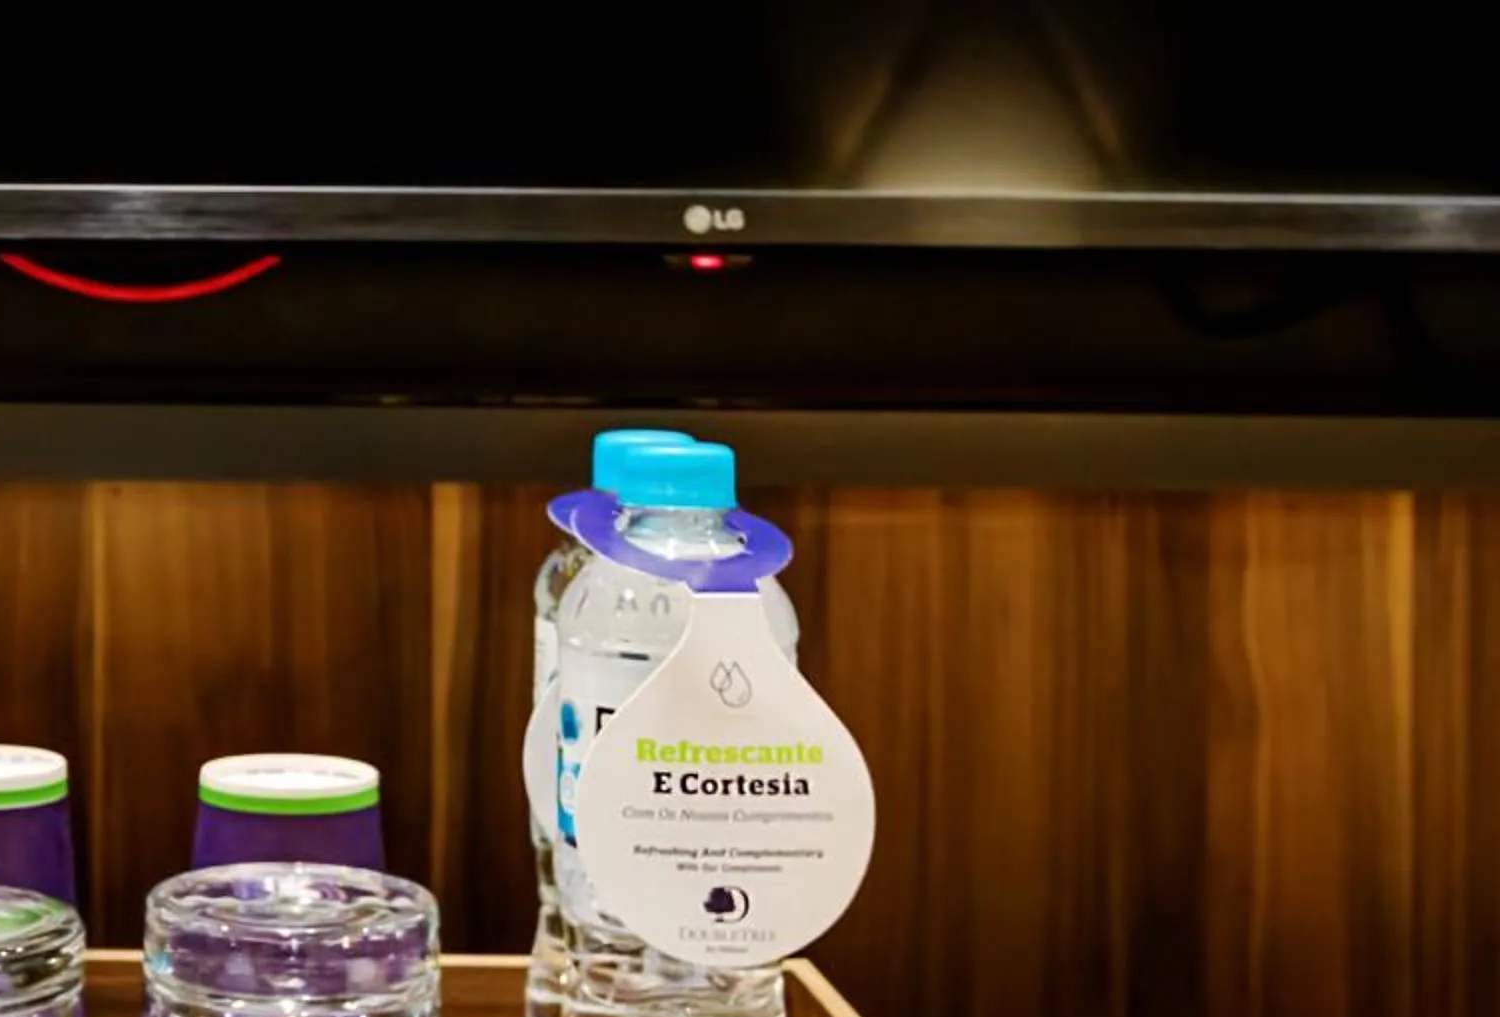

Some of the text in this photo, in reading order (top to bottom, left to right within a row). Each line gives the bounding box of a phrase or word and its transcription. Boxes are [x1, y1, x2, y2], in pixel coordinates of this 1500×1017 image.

[713, 208, 746, 231] LG
[635, 738, 824, 765] Refrescante
[652, 771, 810, 796] E Cortesia
